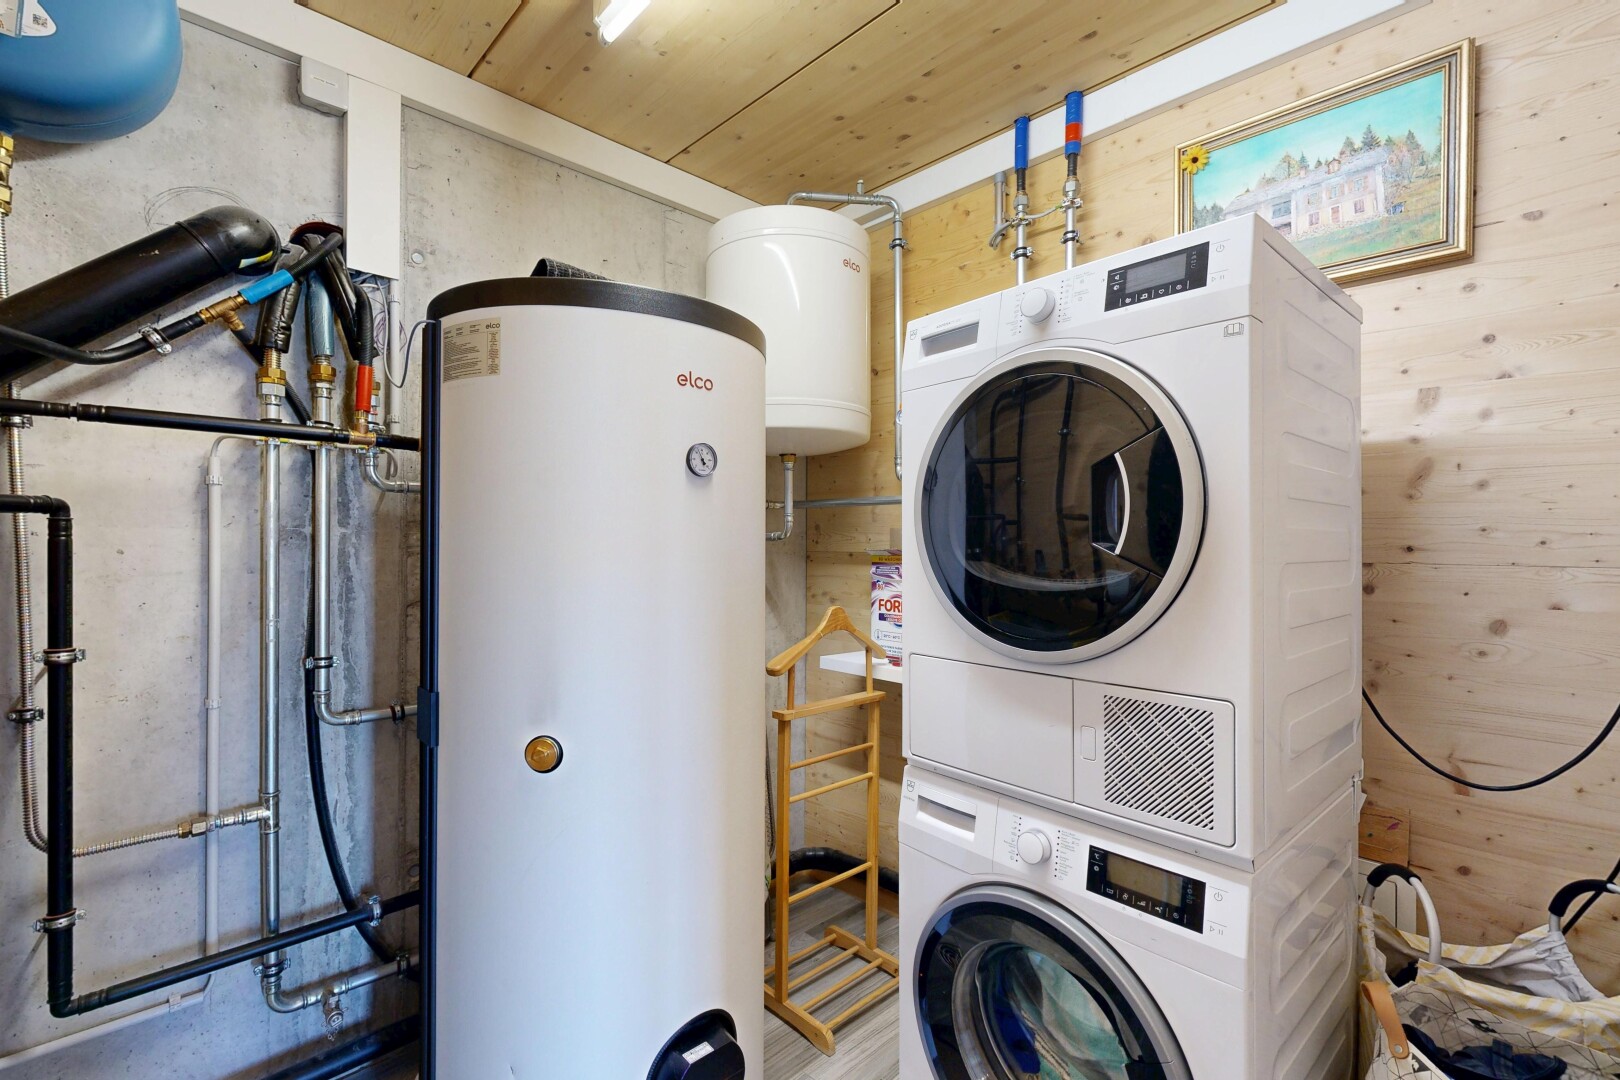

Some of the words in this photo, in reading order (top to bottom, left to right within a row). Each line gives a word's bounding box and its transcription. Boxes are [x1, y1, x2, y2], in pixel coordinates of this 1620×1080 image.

[843, 258, 860, 273] elco
[485, 322, 501, 330] elco
[676, 370, 714, 391] elco
[878, 599, 902, 613] FOR
